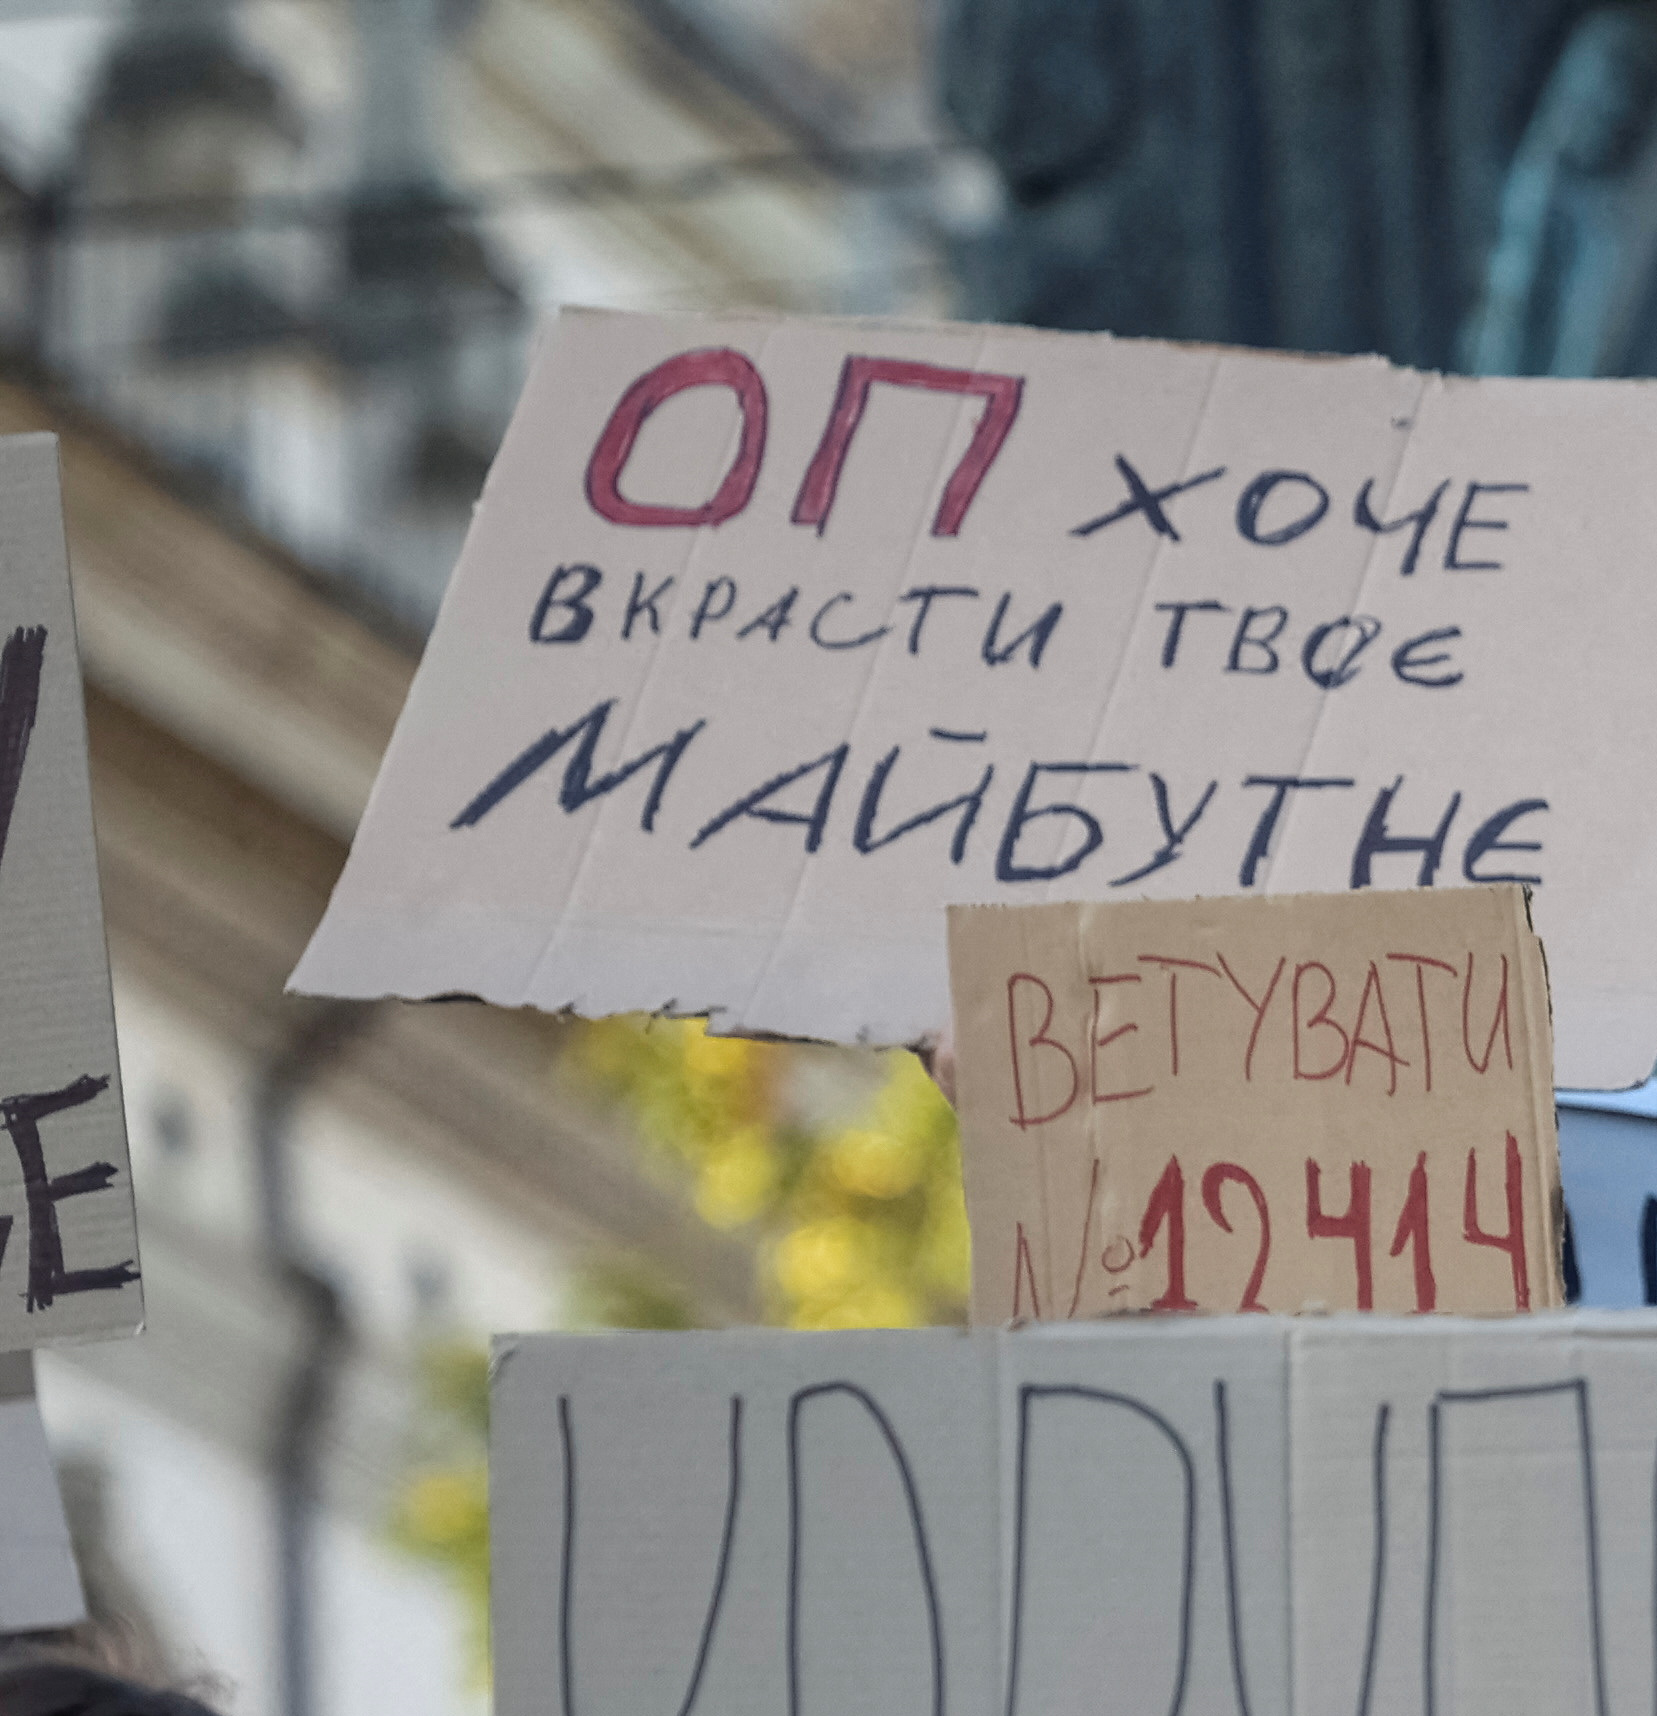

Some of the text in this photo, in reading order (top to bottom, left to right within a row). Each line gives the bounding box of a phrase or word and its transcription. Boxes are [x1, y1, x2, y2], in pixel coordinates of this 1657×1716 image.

[585, 347, 1532, 576] ОП ХОЧЕ
[530, 561, 1468, 692] ВКРАСТИ ТВОЄ
[448, 698, 1553, 889] МАЙБУТНЄ
[1008, 950, 1514, 1131] ВЕТУВАТИ
